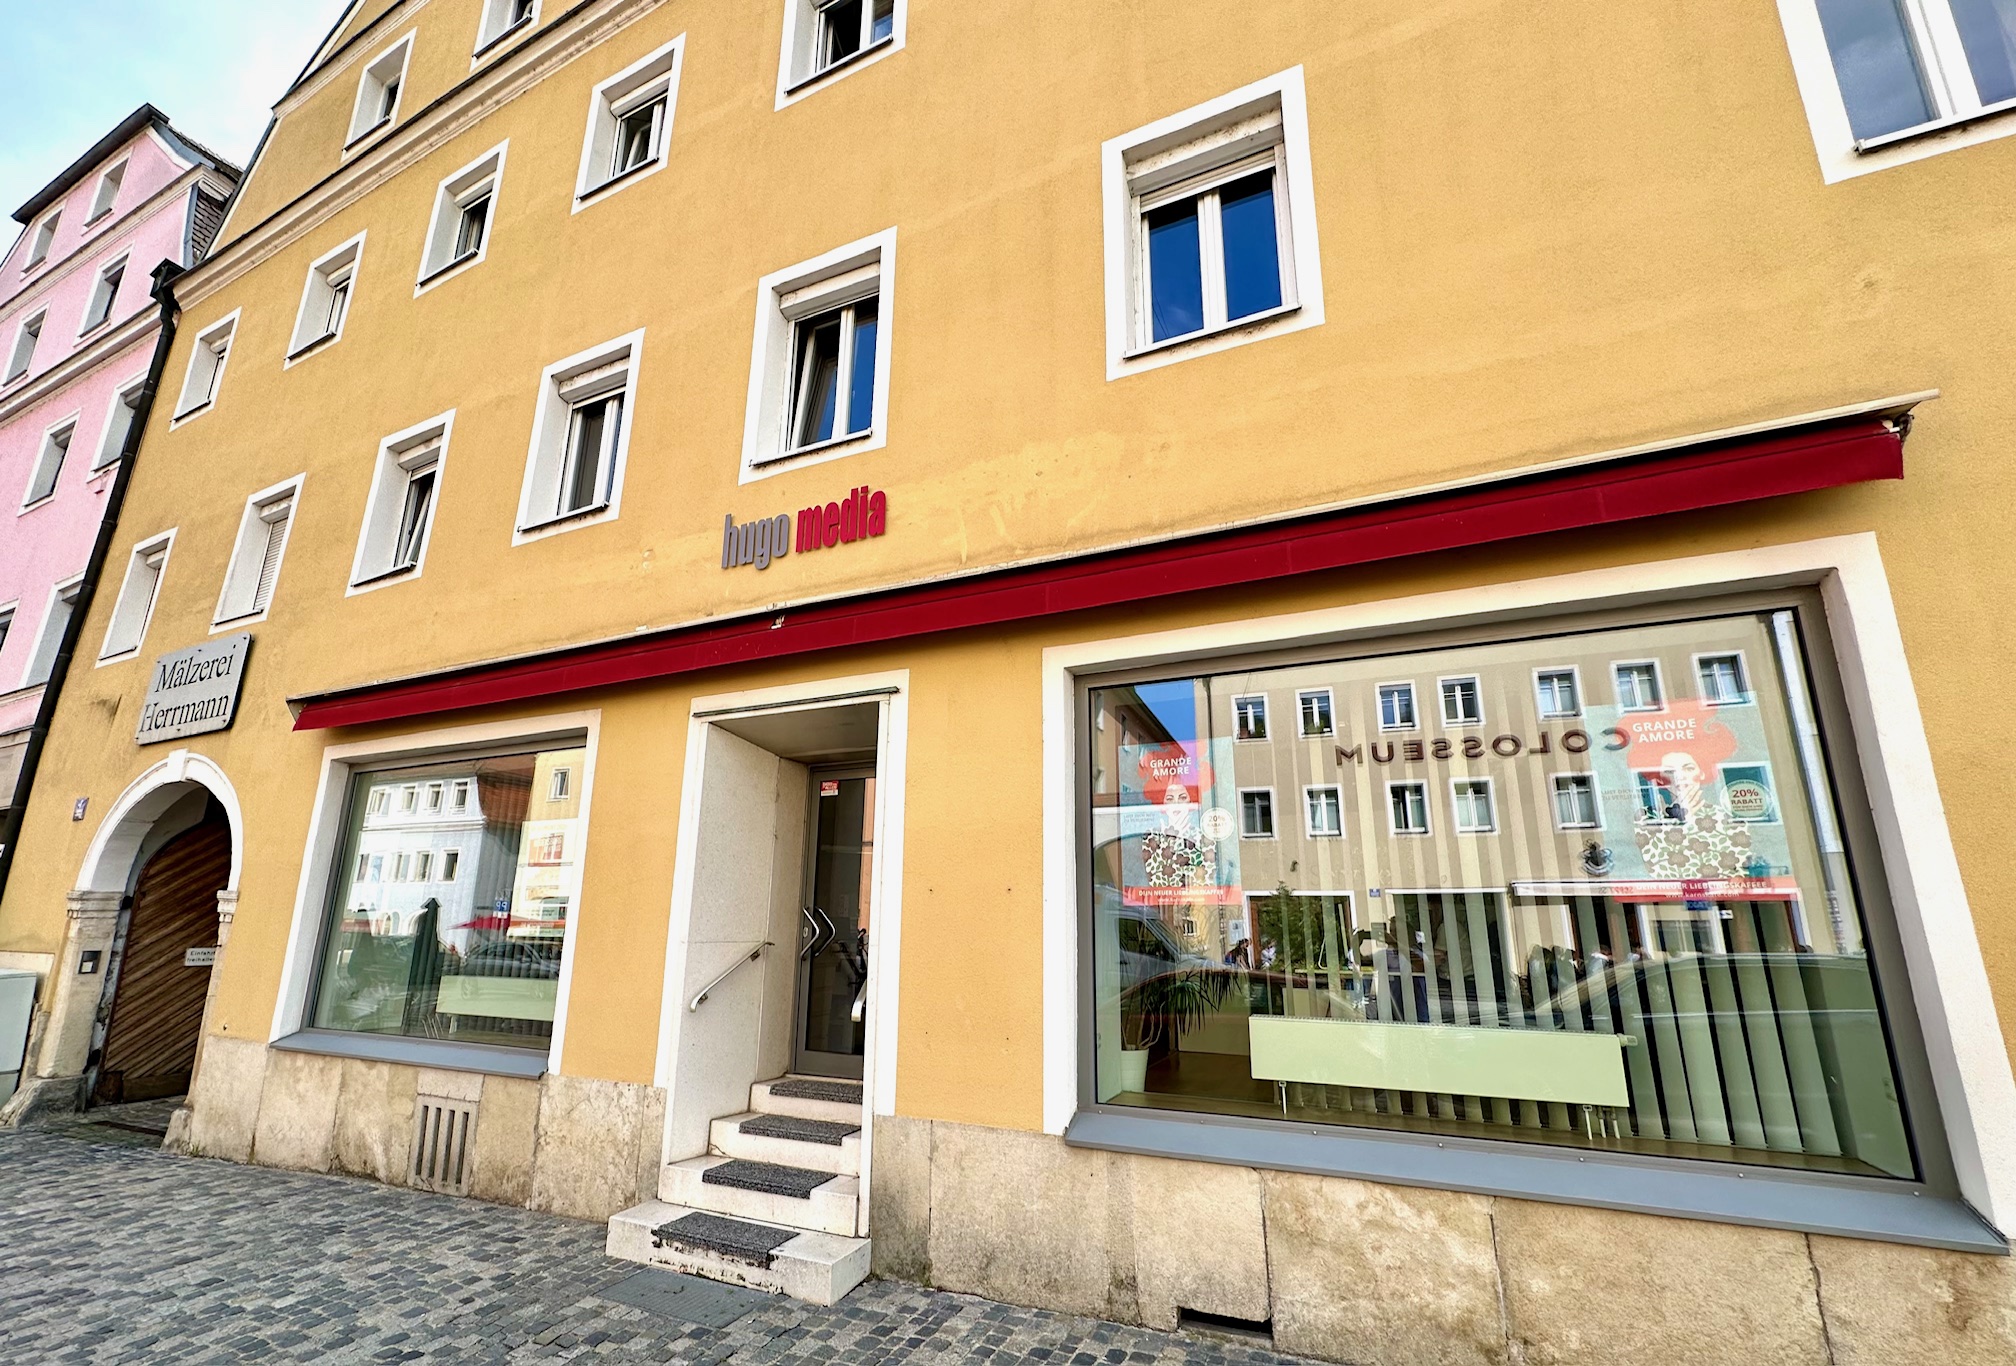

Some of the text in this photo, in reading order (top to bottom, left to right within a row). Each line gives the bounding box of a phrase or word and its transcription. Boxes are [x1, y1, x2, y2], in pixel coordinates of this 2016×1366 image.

[721, 485, 887, 570] hugo media
[154, 644, 237, 693] Mälzerei
[138, 694, 229, 733] Herrmann
[1632, 718, 1697, 732] GRANDE
[1639, 729, 1695, 743] AMORE
[1150, 757, 1191, 768] GRANDE
[1152, 766, 1190, 776] AMORE
[1732, 788, 1760, 798] 20%
[1690, 881, 1767, 889] LIEBLINGSKAFFEE
